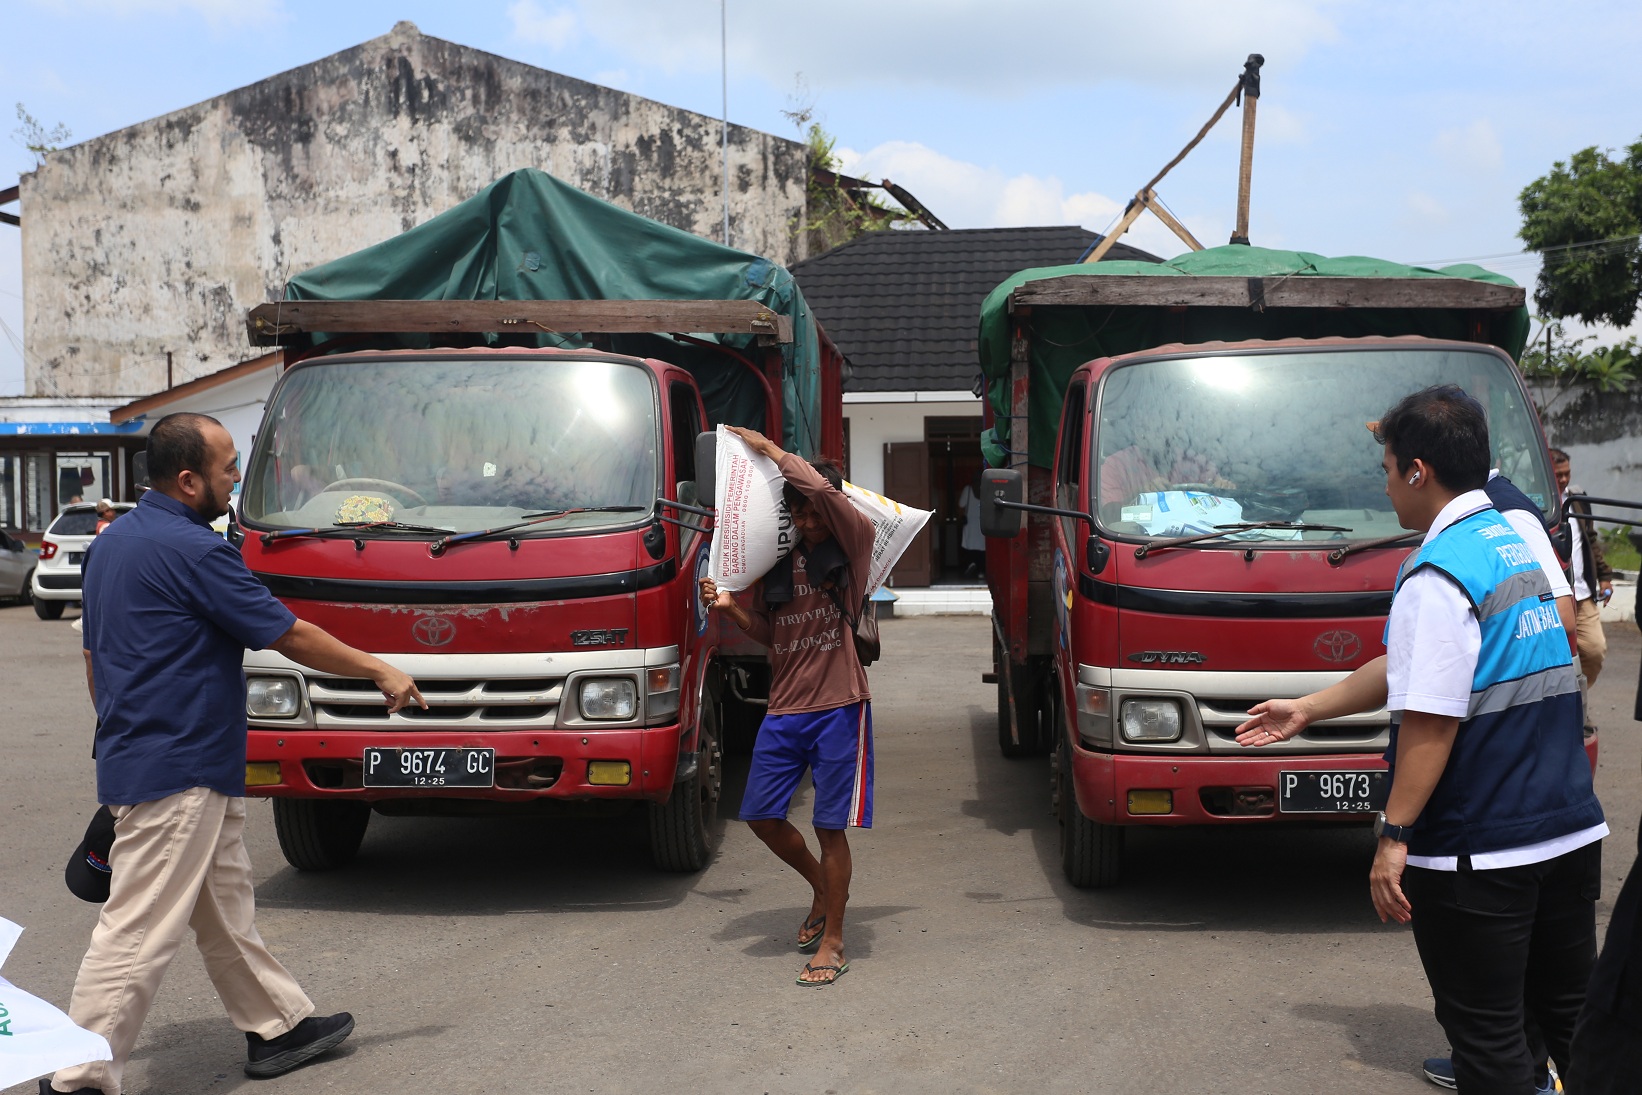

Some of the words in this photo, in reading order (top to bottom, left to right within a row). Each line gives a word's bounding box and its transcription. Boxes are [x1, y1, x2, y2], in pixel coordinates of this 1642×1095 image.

[727, 454, 739, 502] PEMERINTAH
[733, 458, 748, 511] PENGAWASAN
[724, 504, 732, 550] BERSUBSIDI
[732, 513, 740, 540] DALAM
[777, 499, 792, 563] UPUK
[722, 551, 731, 577] PUPUK
[732, 540, 740, 574] BARANG
[1141, 651, 1202, 663] DYNA
[369, 752, 381, 775] P
[400, 751, 446, 774] 9674
[466, 751, 490, 774] GC
[1285, 774, 1298, 798] P
[1319, 774, 1370, 798] 9673
